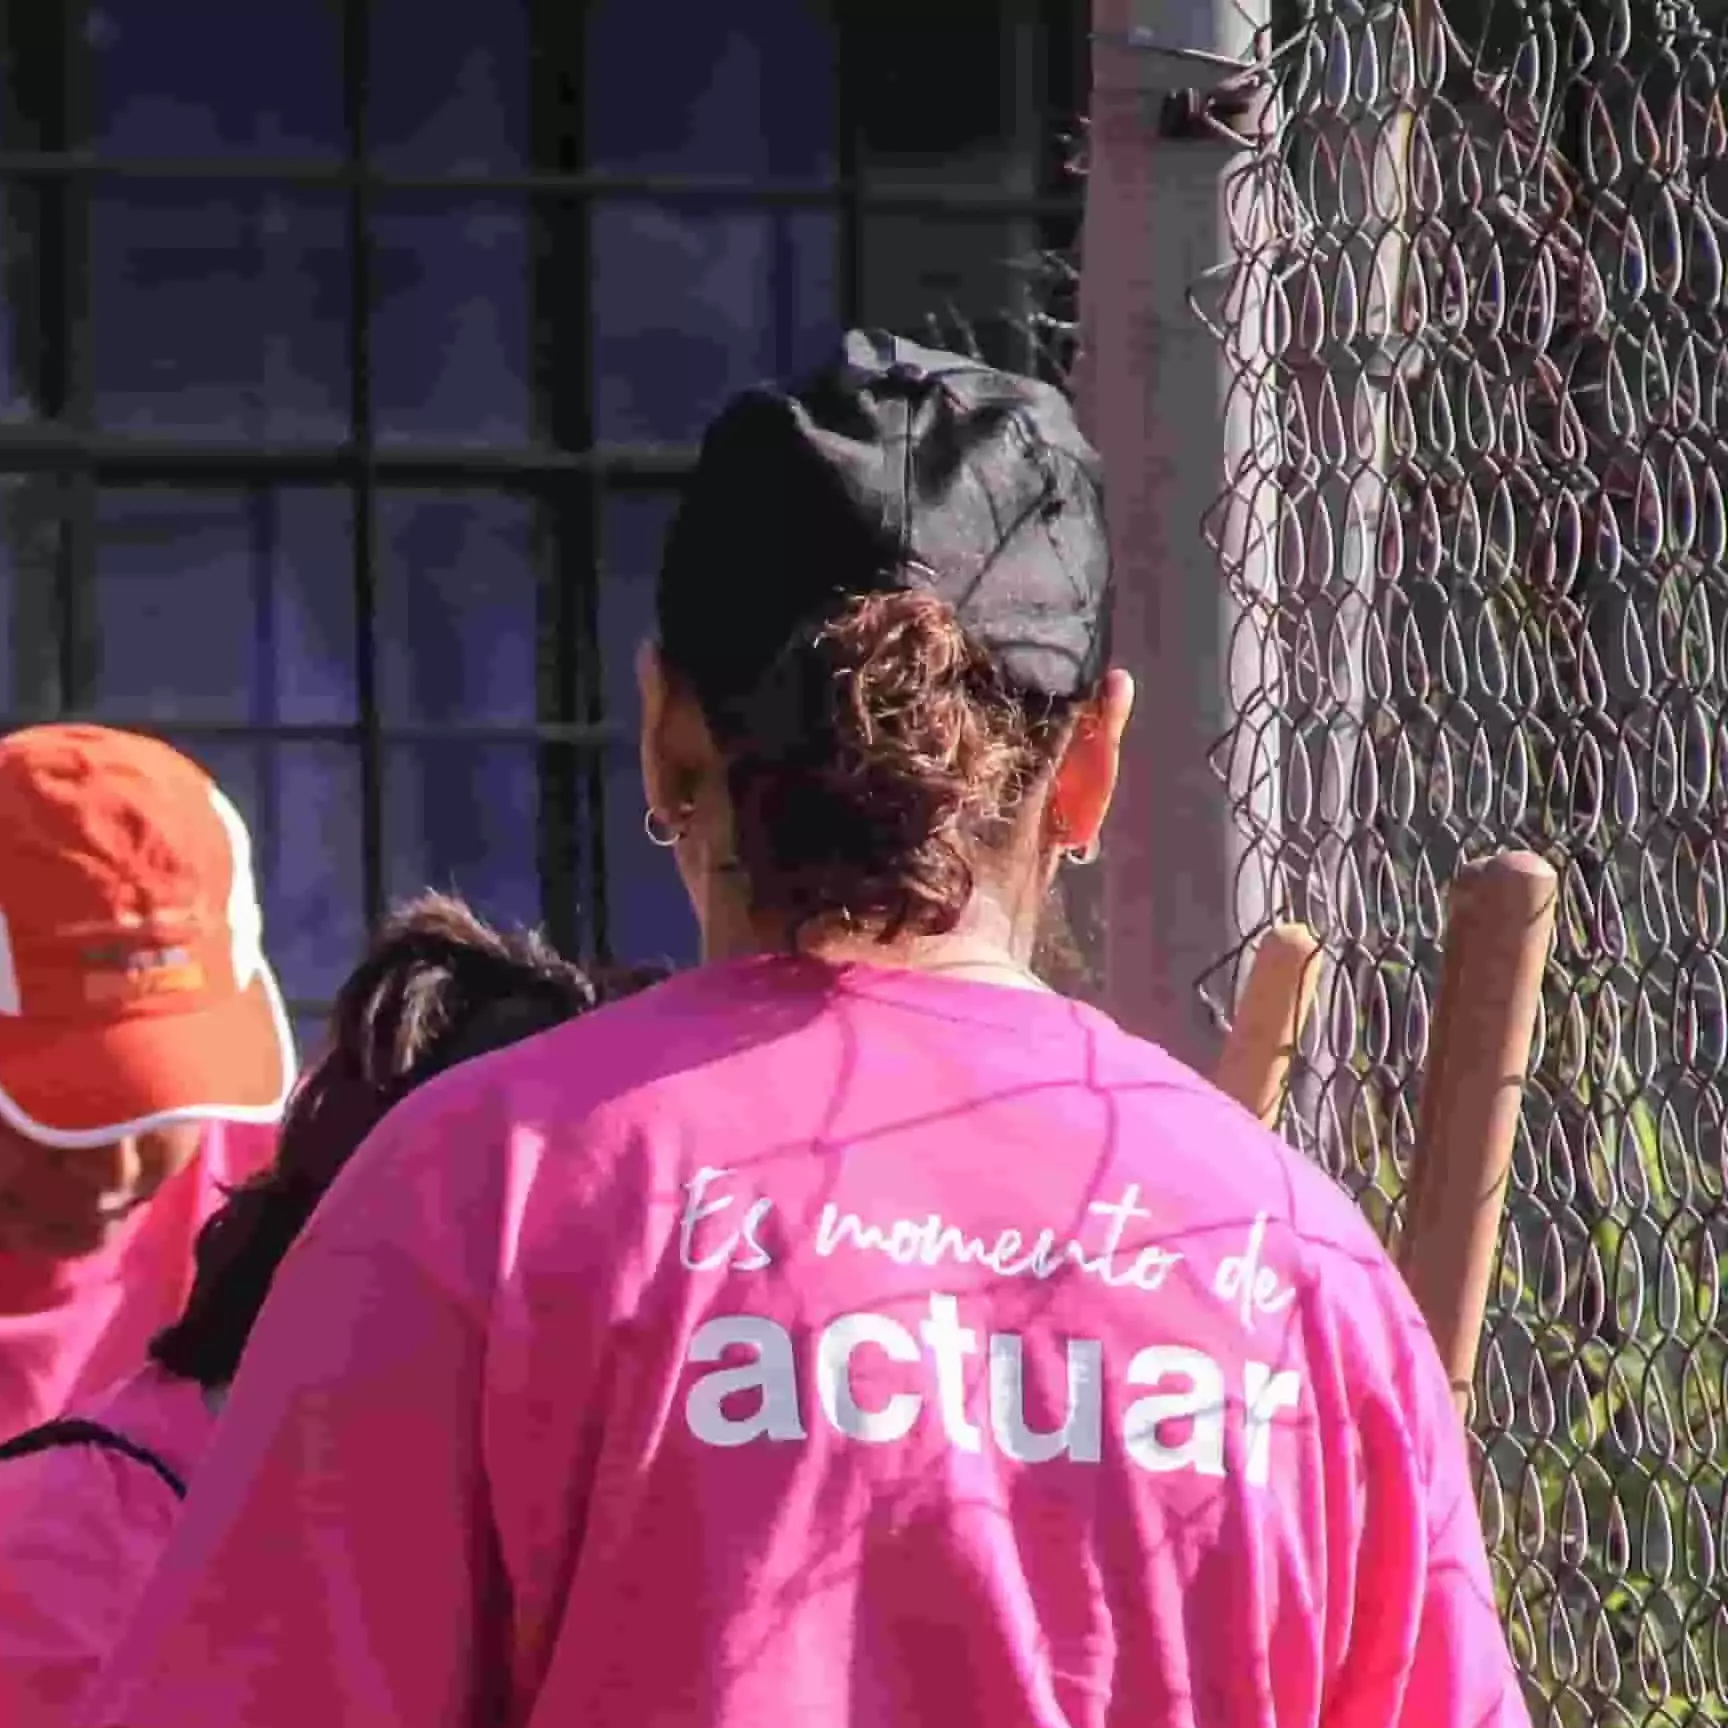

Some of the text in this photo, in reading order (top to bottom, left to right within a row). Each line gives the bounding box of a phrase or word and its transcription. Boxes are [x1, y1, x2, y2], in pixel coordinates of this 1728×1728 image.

[677, 1167, 1298, 1332] Es momento de
[684, 1290, 1301, 1487] actuar
